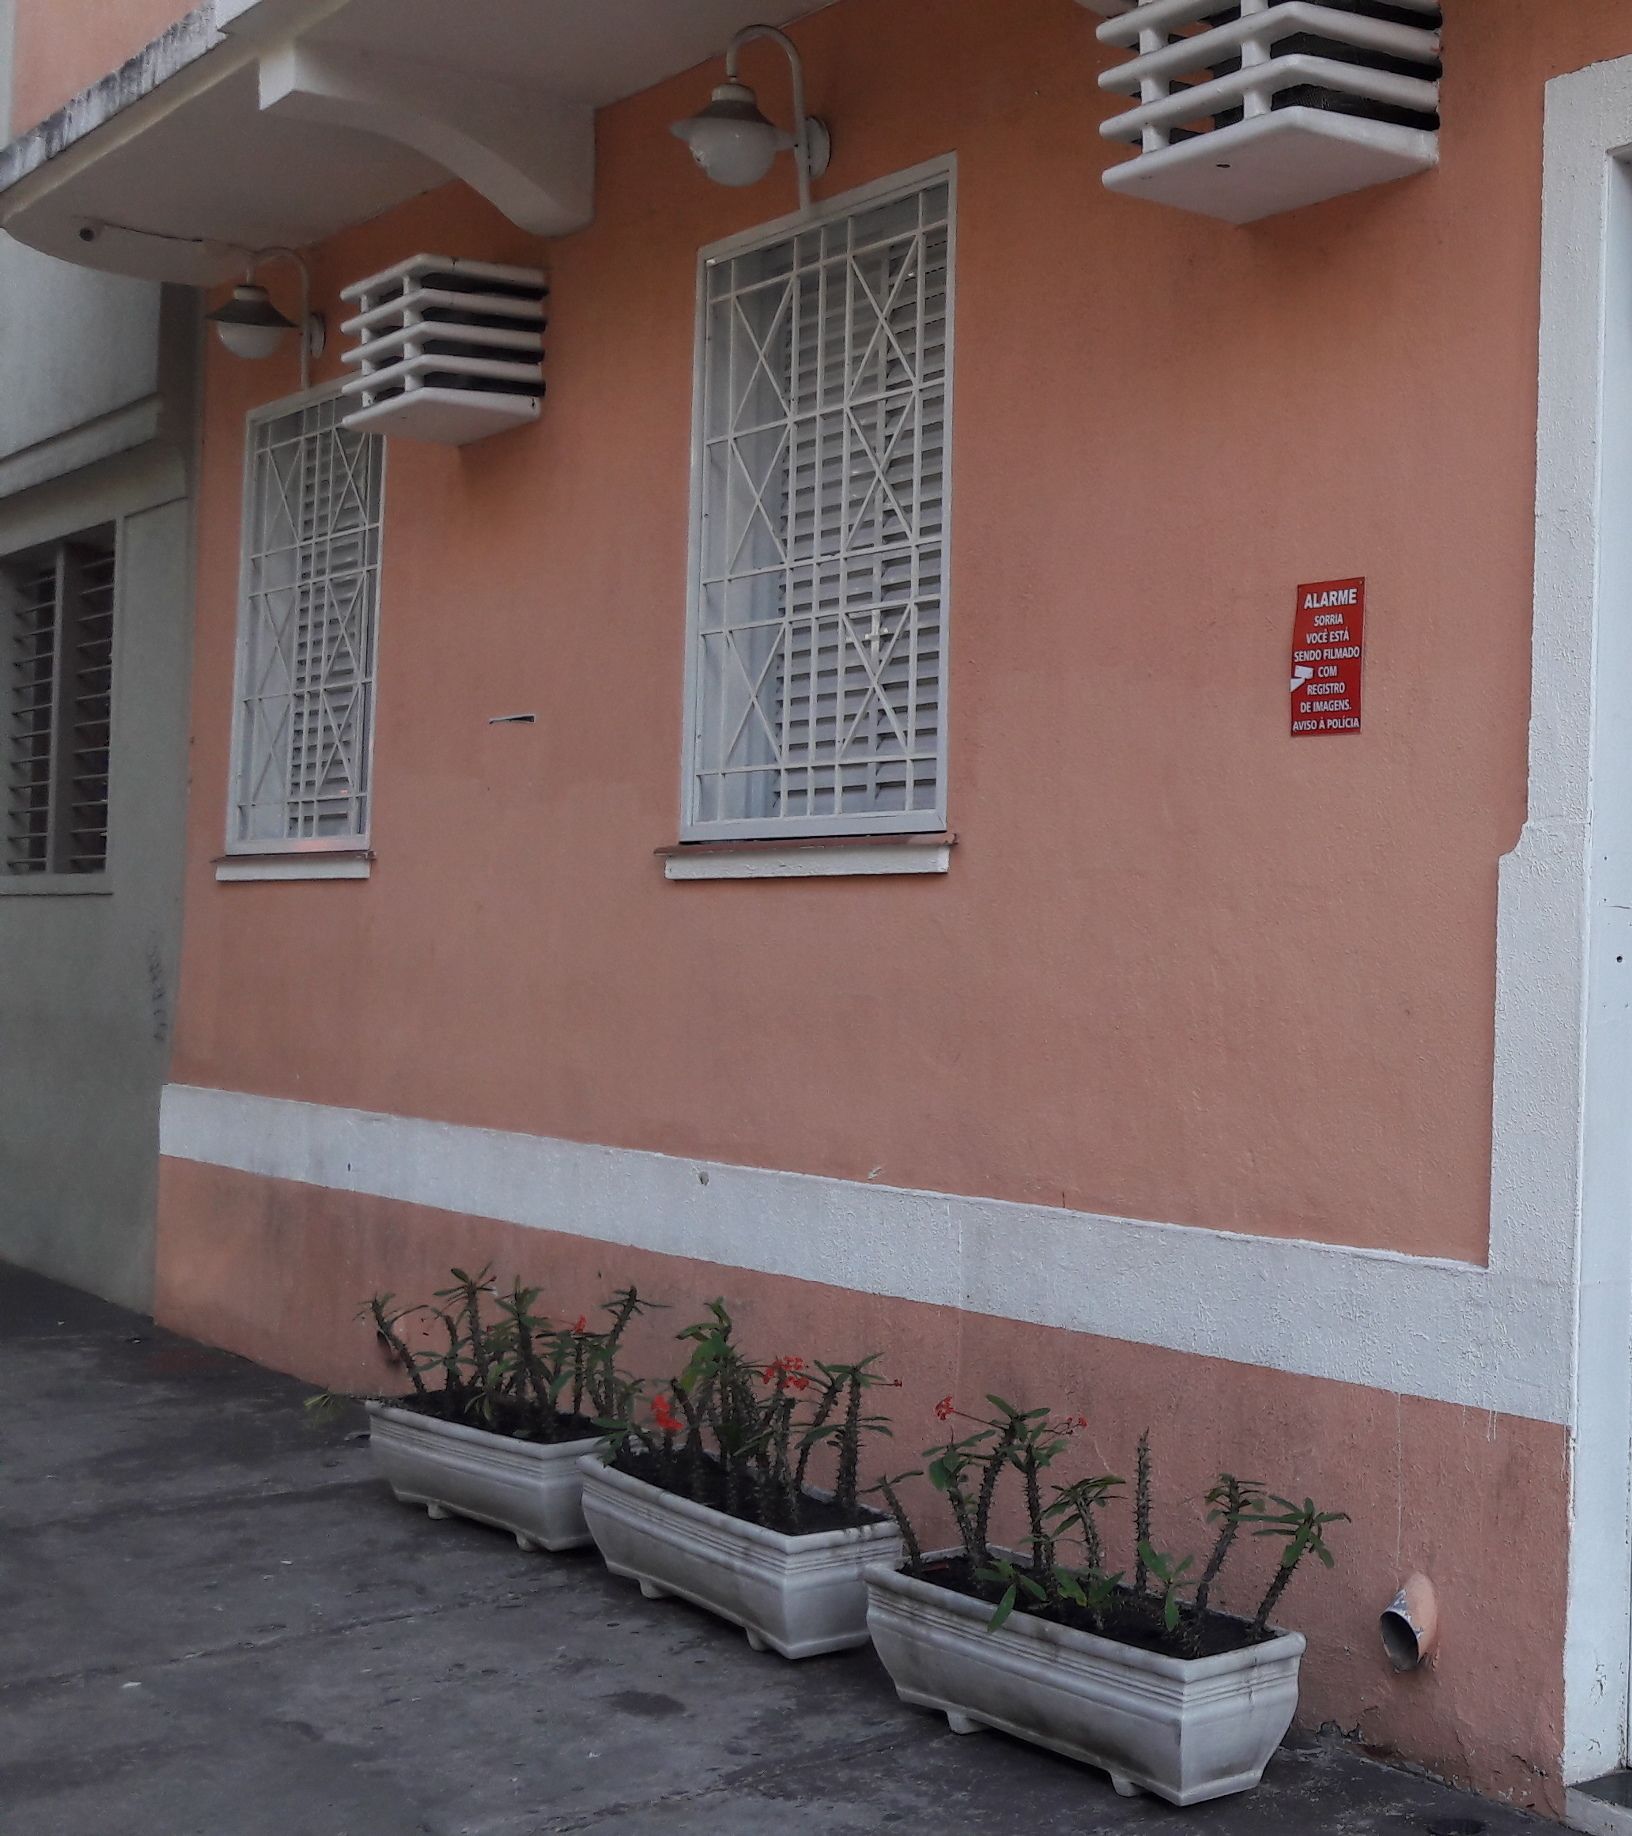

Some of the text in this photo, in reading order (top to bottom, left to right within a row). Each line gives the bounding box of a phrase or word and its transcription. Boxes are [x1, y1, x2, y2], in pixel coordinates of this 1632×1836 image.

[1304, 588, 1357, 609] ALARME
[1314, 613, 1344, 626] SORRIA
[1329, 626, 1350, 643] ESTÁ
[1294, 646, 1360, 663] SENDO FILMADO
[1317, 665, 1338, 677] COM
[1307, 682, 1345, 695] REGISTRO
[1300, 699, 1352, 714] DE IMAGENS.
[1293, 720, 1317, 732] AVISO
[1327, 715, 1360, 729] POLÍCIA
